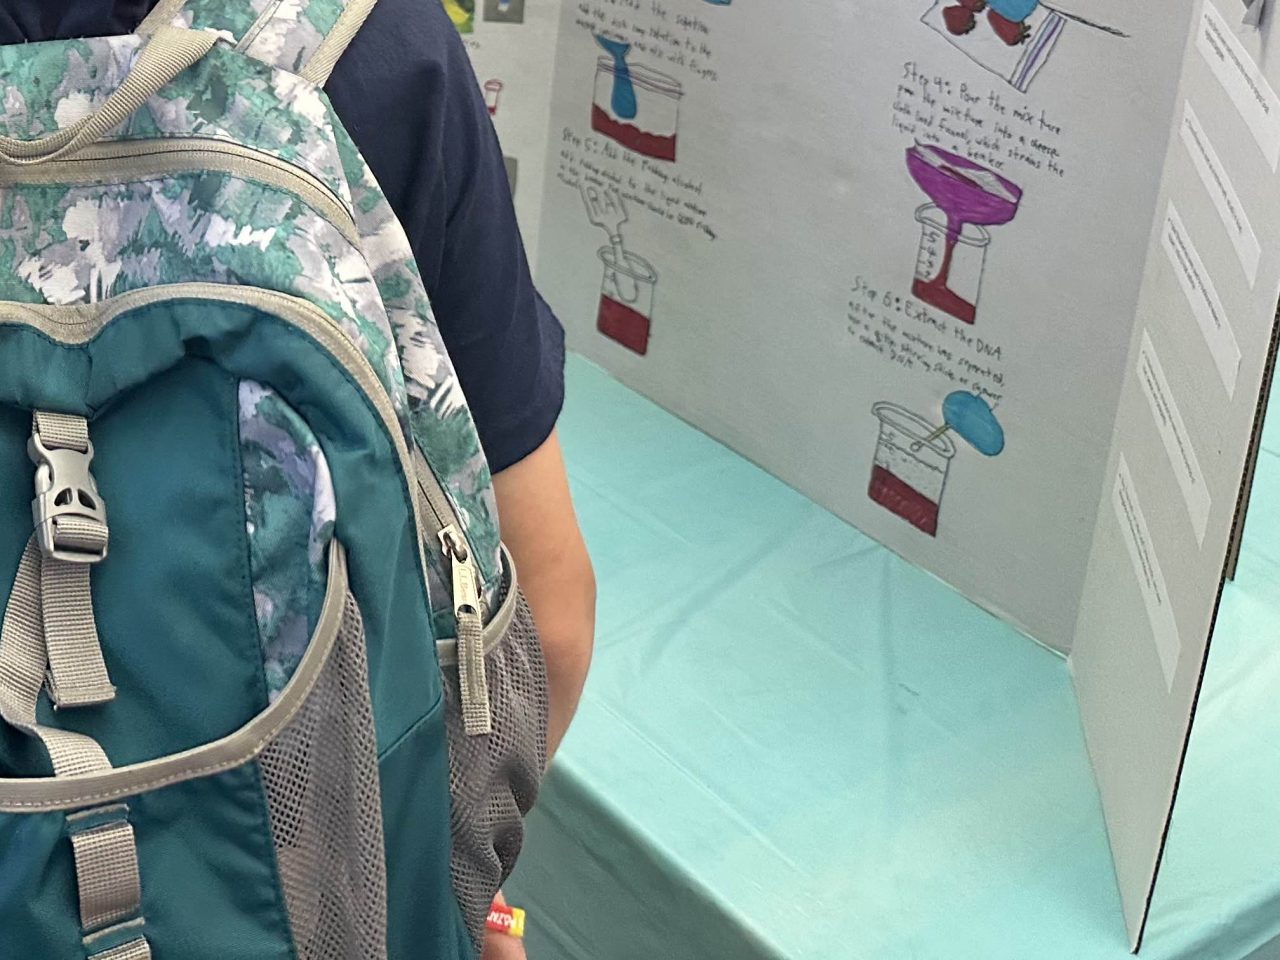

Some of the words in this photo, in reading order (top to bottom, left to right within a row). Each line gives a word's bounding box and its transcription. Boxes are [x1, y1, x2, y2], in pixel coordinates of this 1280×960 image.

[987, 90, 1006, 116] the
[1048, 158, 1065, 178] the
[975, 338, 1003, 361] DNA
